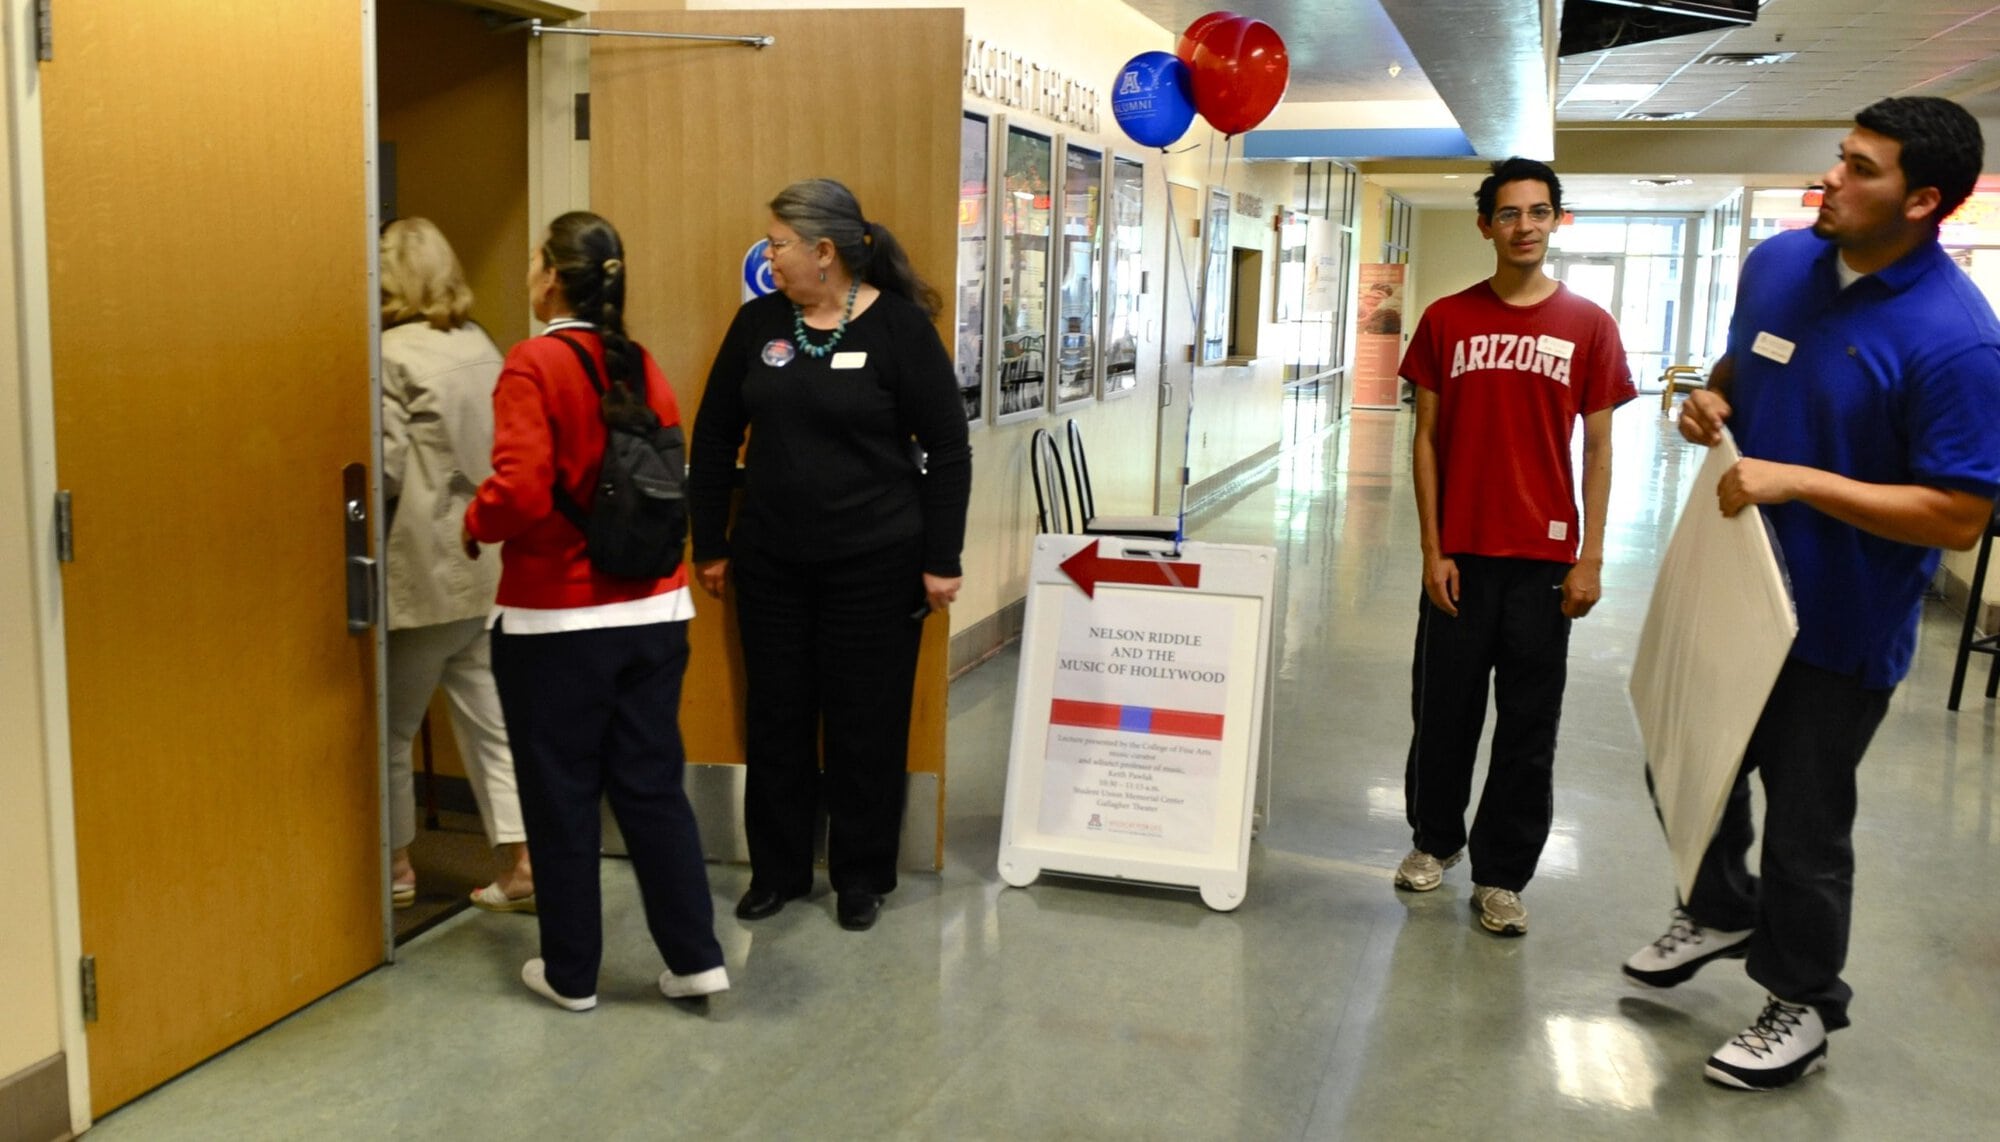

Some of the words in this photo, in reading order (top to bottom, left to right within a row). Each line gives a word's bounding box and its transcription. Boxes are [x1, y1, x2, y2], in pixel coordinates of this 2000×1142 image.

[1120, 71, 1141, 95] A
[1451, 334, 1571, 388] ARIZONA
[1089, 627, 1145, 642] NELSON
[1148, 632, 1202, 647] RIDDLE
[1110, 647, 1143, 659] AND
[1147, 649, 1176, 662] THE
[1059, 659, 1105, 674] MUSIC
[1107, 663, 1127, 675] OF
[1130, 665, 1225, 684] HOLLYWOOD
[1057, 734, 1083, 744] Lecture
[1084, 738, 1118, 747] presented
[1120, 740, 1128, 749] by
[1129, 741, 1140, 749] the
[1142, 743, 1168, 753] College
[1178, 746, 1193, 754] Fine
[1195, 747, 1212, 756] Arts
[1078, 757, 1091, 765] and
[1108, 769, 1127, 778] Keith
[1073, 785, 1099, 795] Student
[1101, 788, 1123, 797] Union
[1125, 791, 1159, 801] Memorial
[1160, 795, 1185, 804] Center
[1096, 799, 1129, 811] Gallagher
[1131, 801, 1158, 812] Theater
